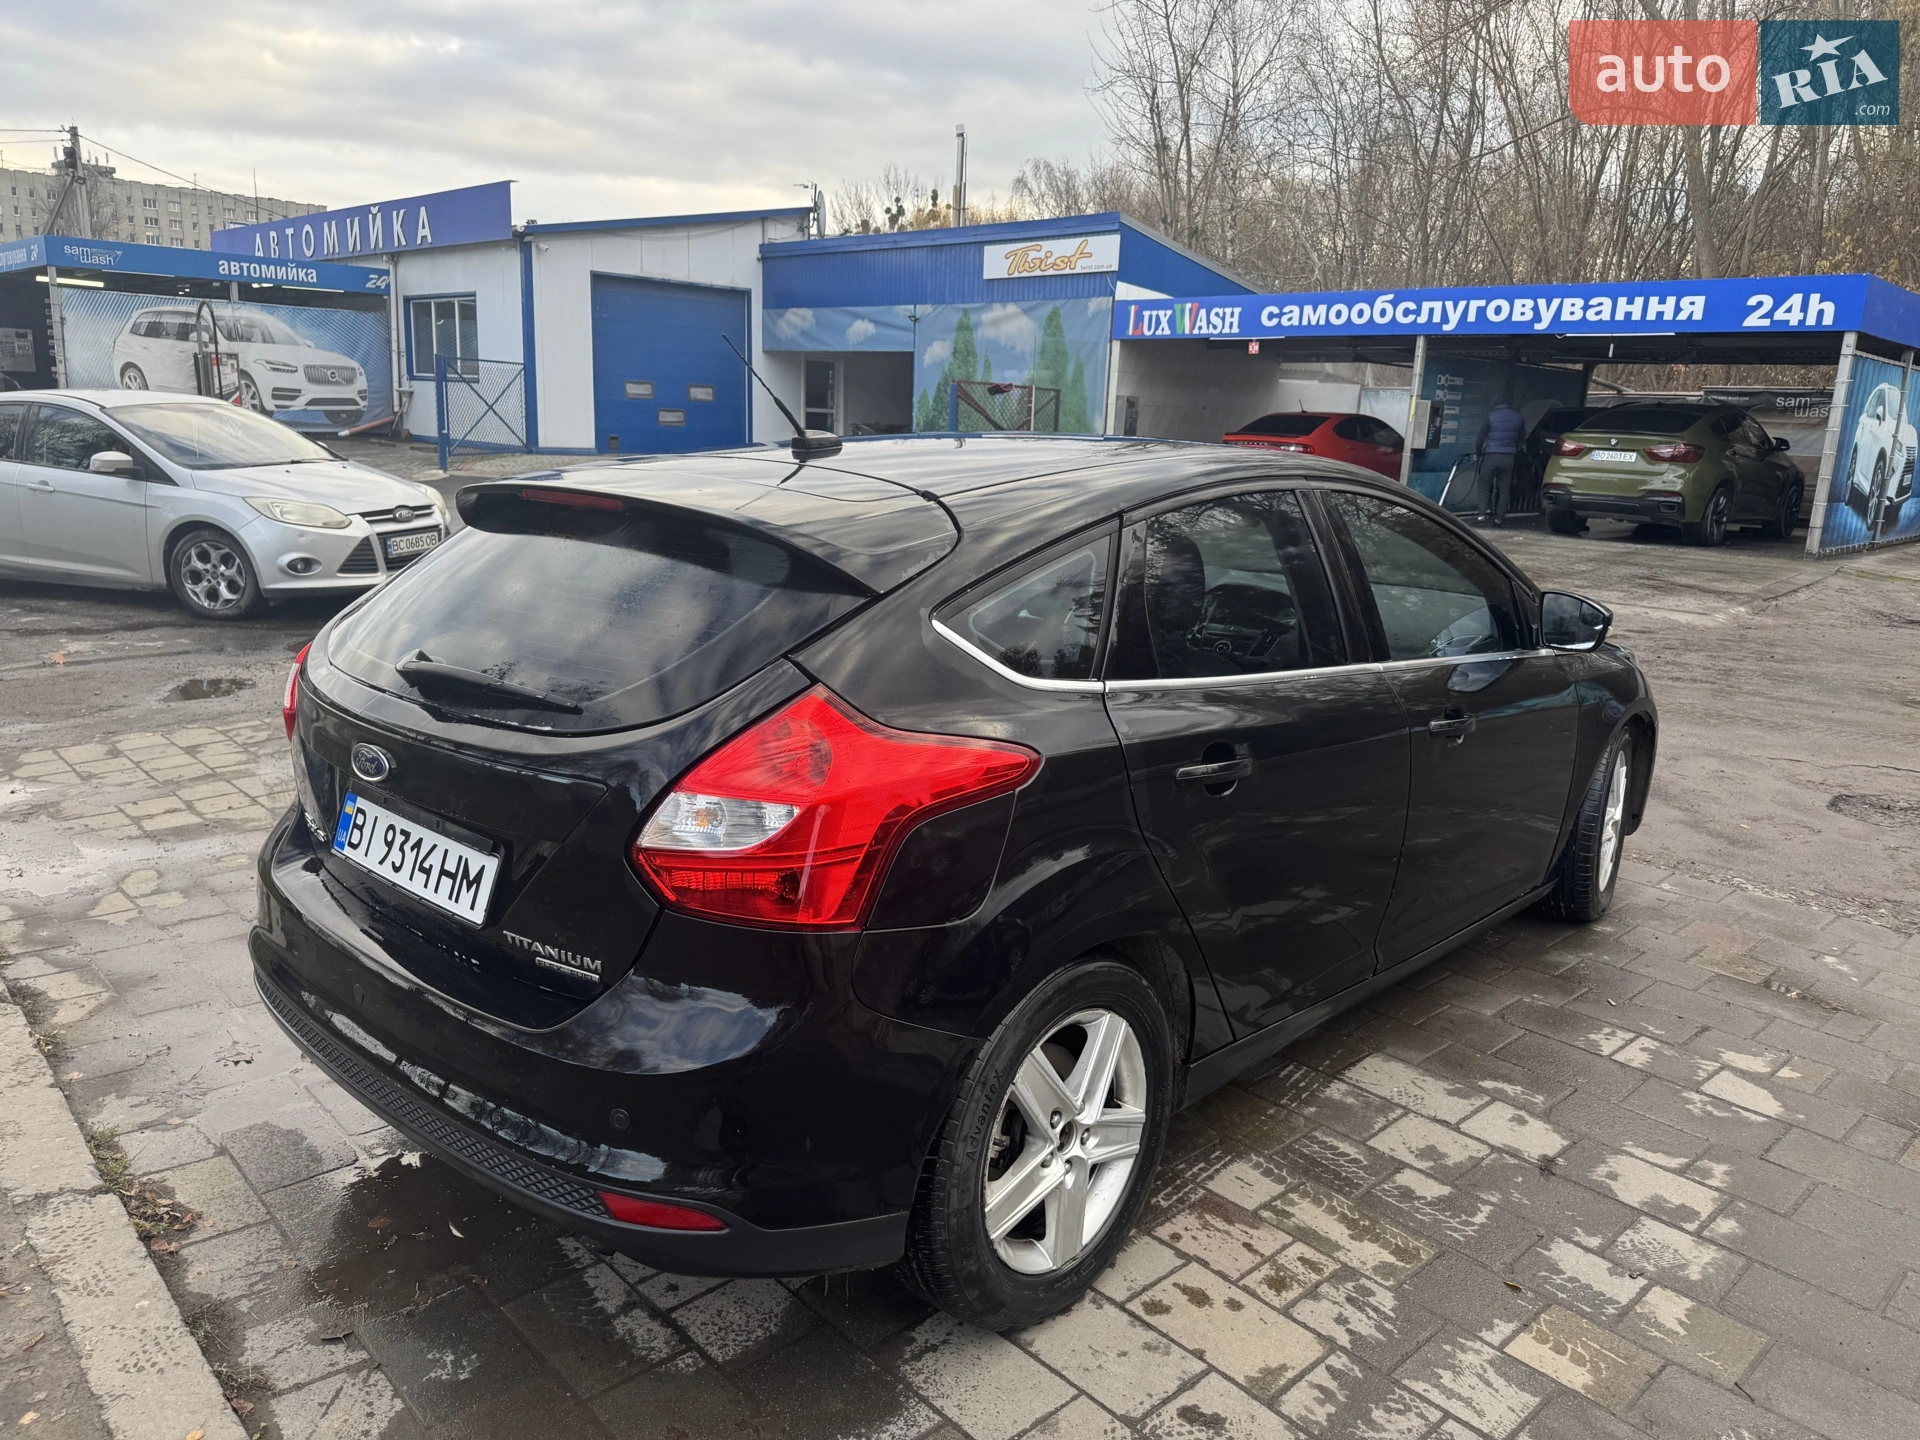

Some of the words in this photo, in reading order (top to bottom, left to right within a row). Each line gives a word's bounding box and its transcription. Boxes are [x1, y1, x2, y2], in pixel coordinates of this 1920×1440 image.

[254, 205, 433, 260] АВТОМИЙКА
[1004, 239, 1093, 276] Twist
[1080, 263, 1113, 271] twist.com.ua
[218, 259, 318, 284] автомийка
[1260, 293, 1707, 331] самообслуговування
[1742, 293, 1836, 327] 24h
[1775, 397, 1810, 408] sam
[1794, 406, 1829, 418] was
[356, 749, 378, 775] Ford
[338, 829, 347, 844] UA
[502, 929, 602, 973] TITANIUM
